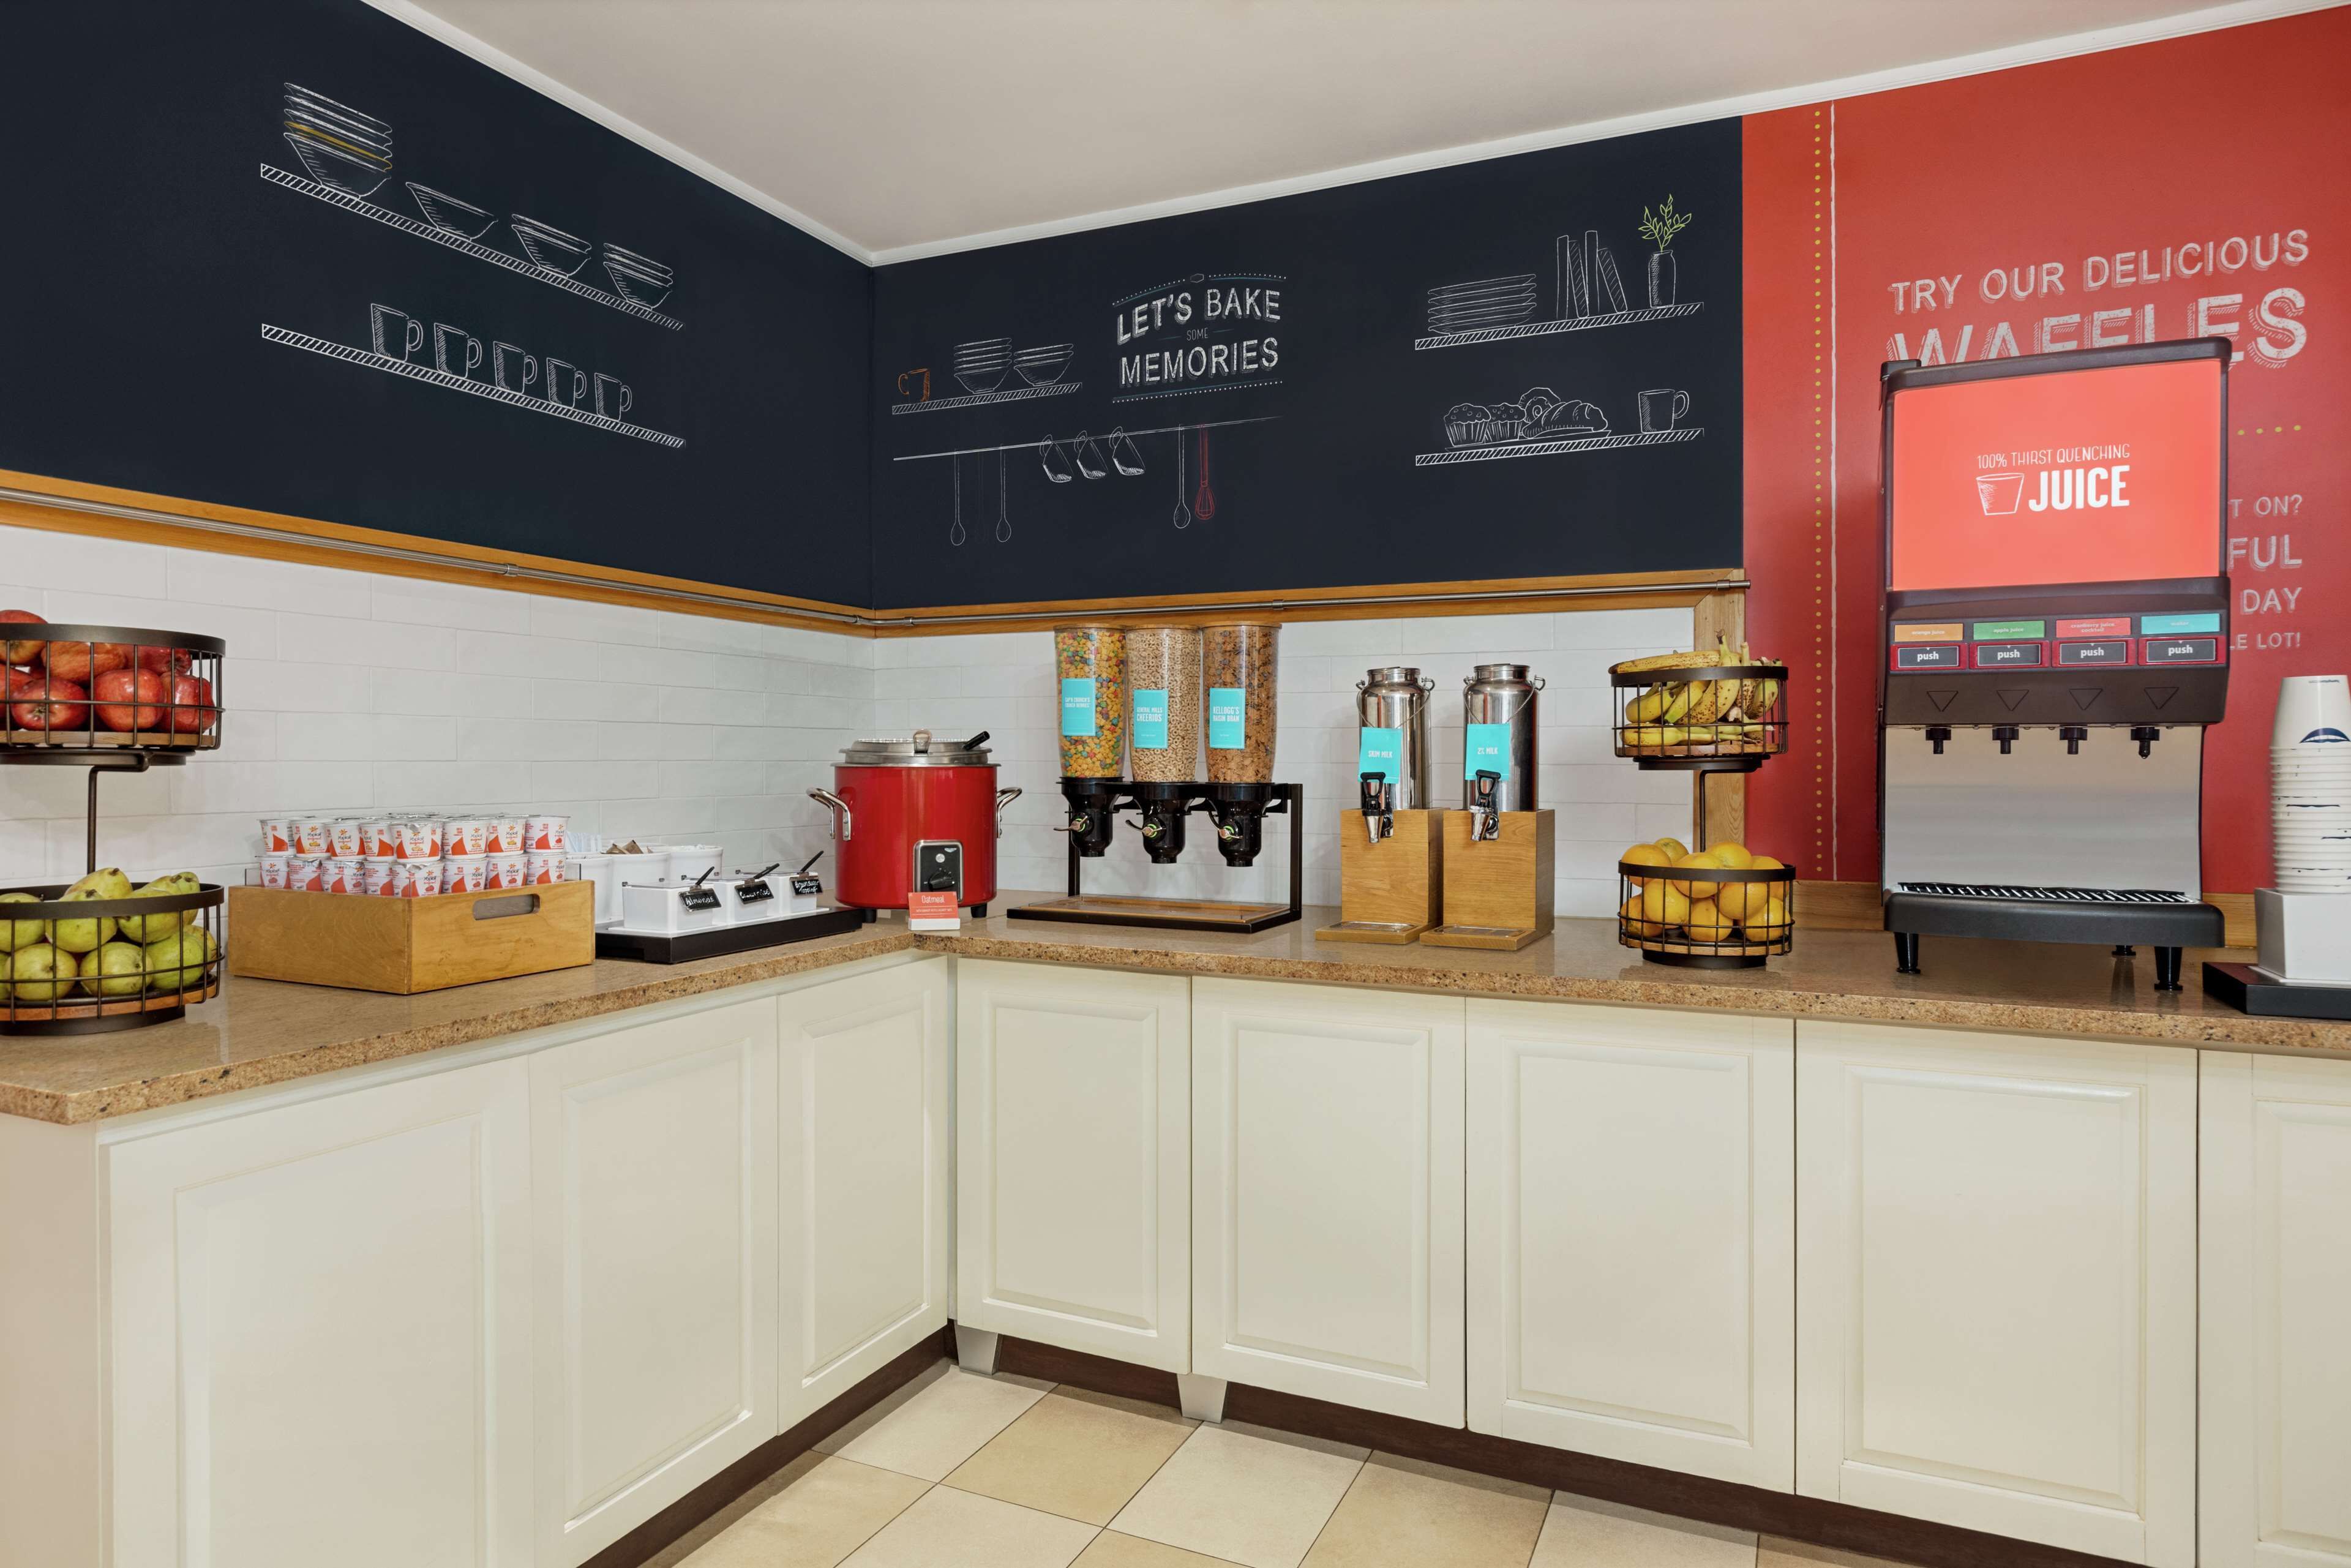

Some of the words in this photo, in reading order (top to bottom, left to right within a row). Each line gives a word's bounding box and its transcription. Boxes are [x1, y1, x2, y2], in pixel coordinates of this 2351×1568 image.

[1889, 274, 1962, 313] TRY
[1979, 261, 2065, 303] OUR
[2083, 229, 2309, 291] DELICIOUS
[1117, 292, 1192, 345] LET'S
[1205, 288, 1281, 321] BAKE
[1186, 327, 1209, 341] SOME
[1120, 337, 1278, 388] MEMORIES
[1978, 453, 2007, 469] 100%
[2011, 449, 2053, 466] THIRST
[2057, 443, 2130, 463] QUENCHING
[2028, 465, 2130, 512] JUICE
[2254, 494, 2303, 517] ON?
[2240, 587, 2302, 615] DAY
[2230, 634, 2248, 650] E
[2257, 632, 2301, 650] LOT!
[1917, 651, 1940, 662] push
[1997, 649, 2020, 660] push
[2080, 647, 2105, 658] push
[2168, 645, 2193, 656] push
[1137, 713, 1162, 722] CHEERIOS
[1213, 706, 1239, 715] KELLOGG'S
[685, 895, 715, 907] Almonds
[921, 895, 945, 904] Oatmeal
